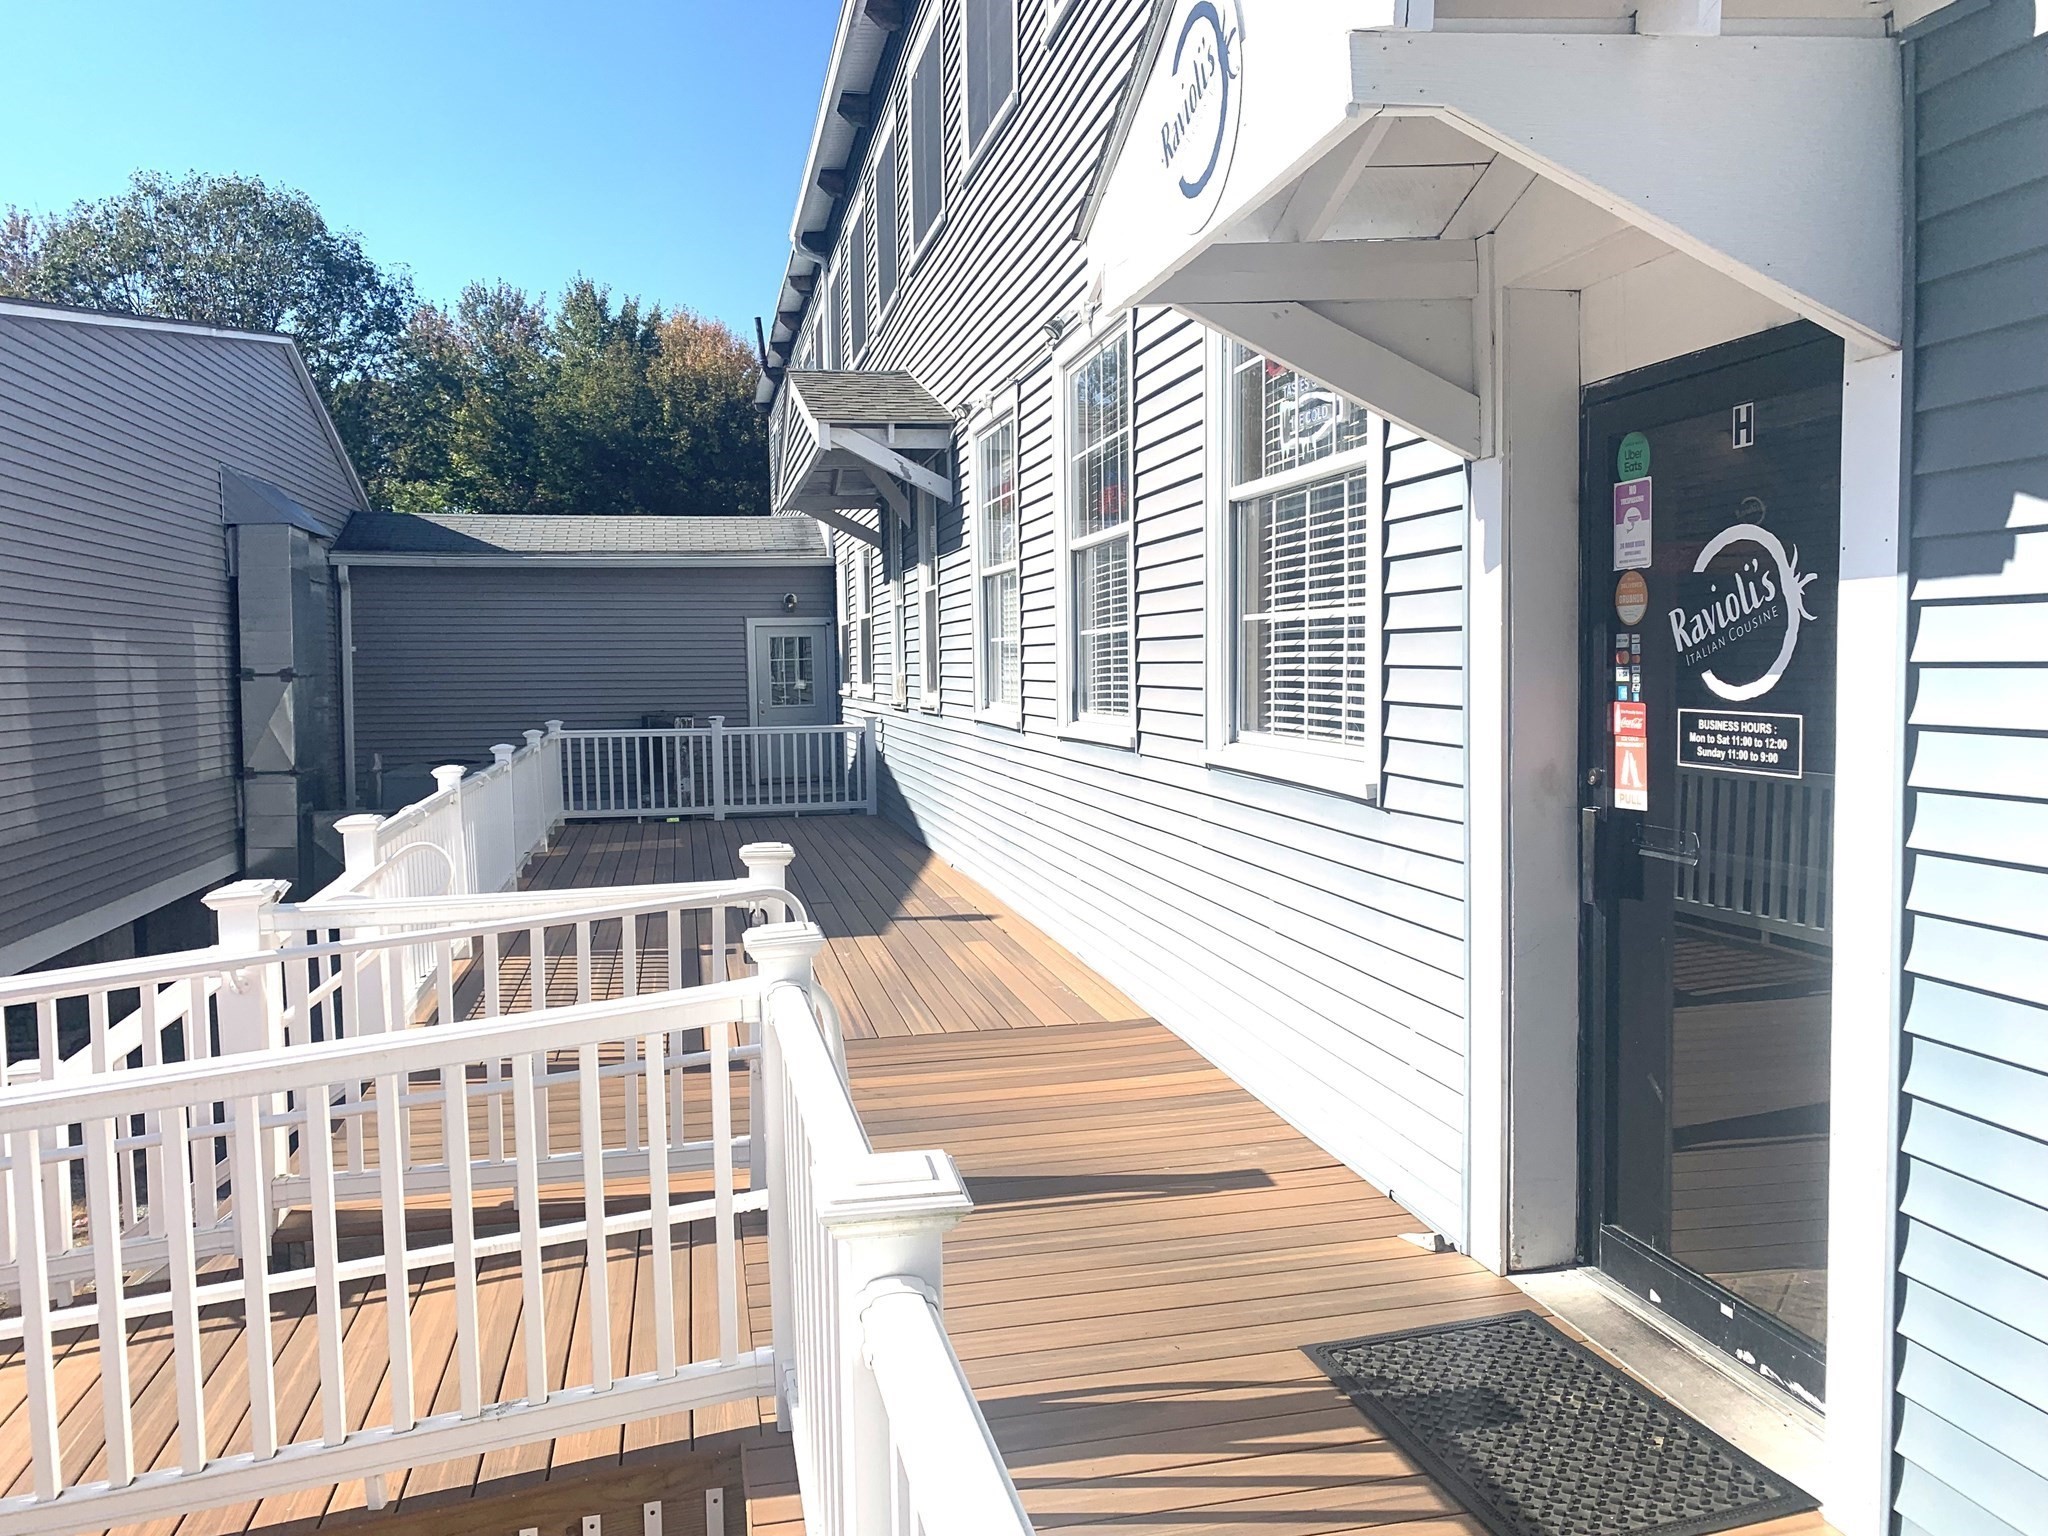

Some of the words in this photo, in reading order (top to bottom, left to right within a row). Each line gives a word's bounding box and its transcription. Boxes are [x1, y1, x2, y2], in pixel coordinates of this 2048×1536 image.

[1161, 37, 1215, 168] Ravioli's
[1624, 449, 1642, 460] Uber
[1624, 461, 1642, 472] Eats
[1668, 558, 1776, 653] Ravioli's
[1685, 637, 1726, 667] ITALIAN
[1728, 605, 1779, 641] COUSINE
[1698, 719, 1740, 732] BUSINESS
[1741, 721, 1772, 734] HOURS
[1689, 732, 1706, 743] Mon
[1707, 734, 1715, 744] to
[1716, 733, 1730, 745] Sat
[1731, 735, 1753, 747] 11:00
[1754, 737, 1763, 748] to
[1764, 738, 1788, 750] 12:00
[1697, 746, 1725, 760] Sunday
[1727, 749, 1748, 760] 11:00
[1750, 751, 1759, 762] to
[1760, 752, 1779, 763] 9:00
[1619, 793, 1642, 805] PULL
